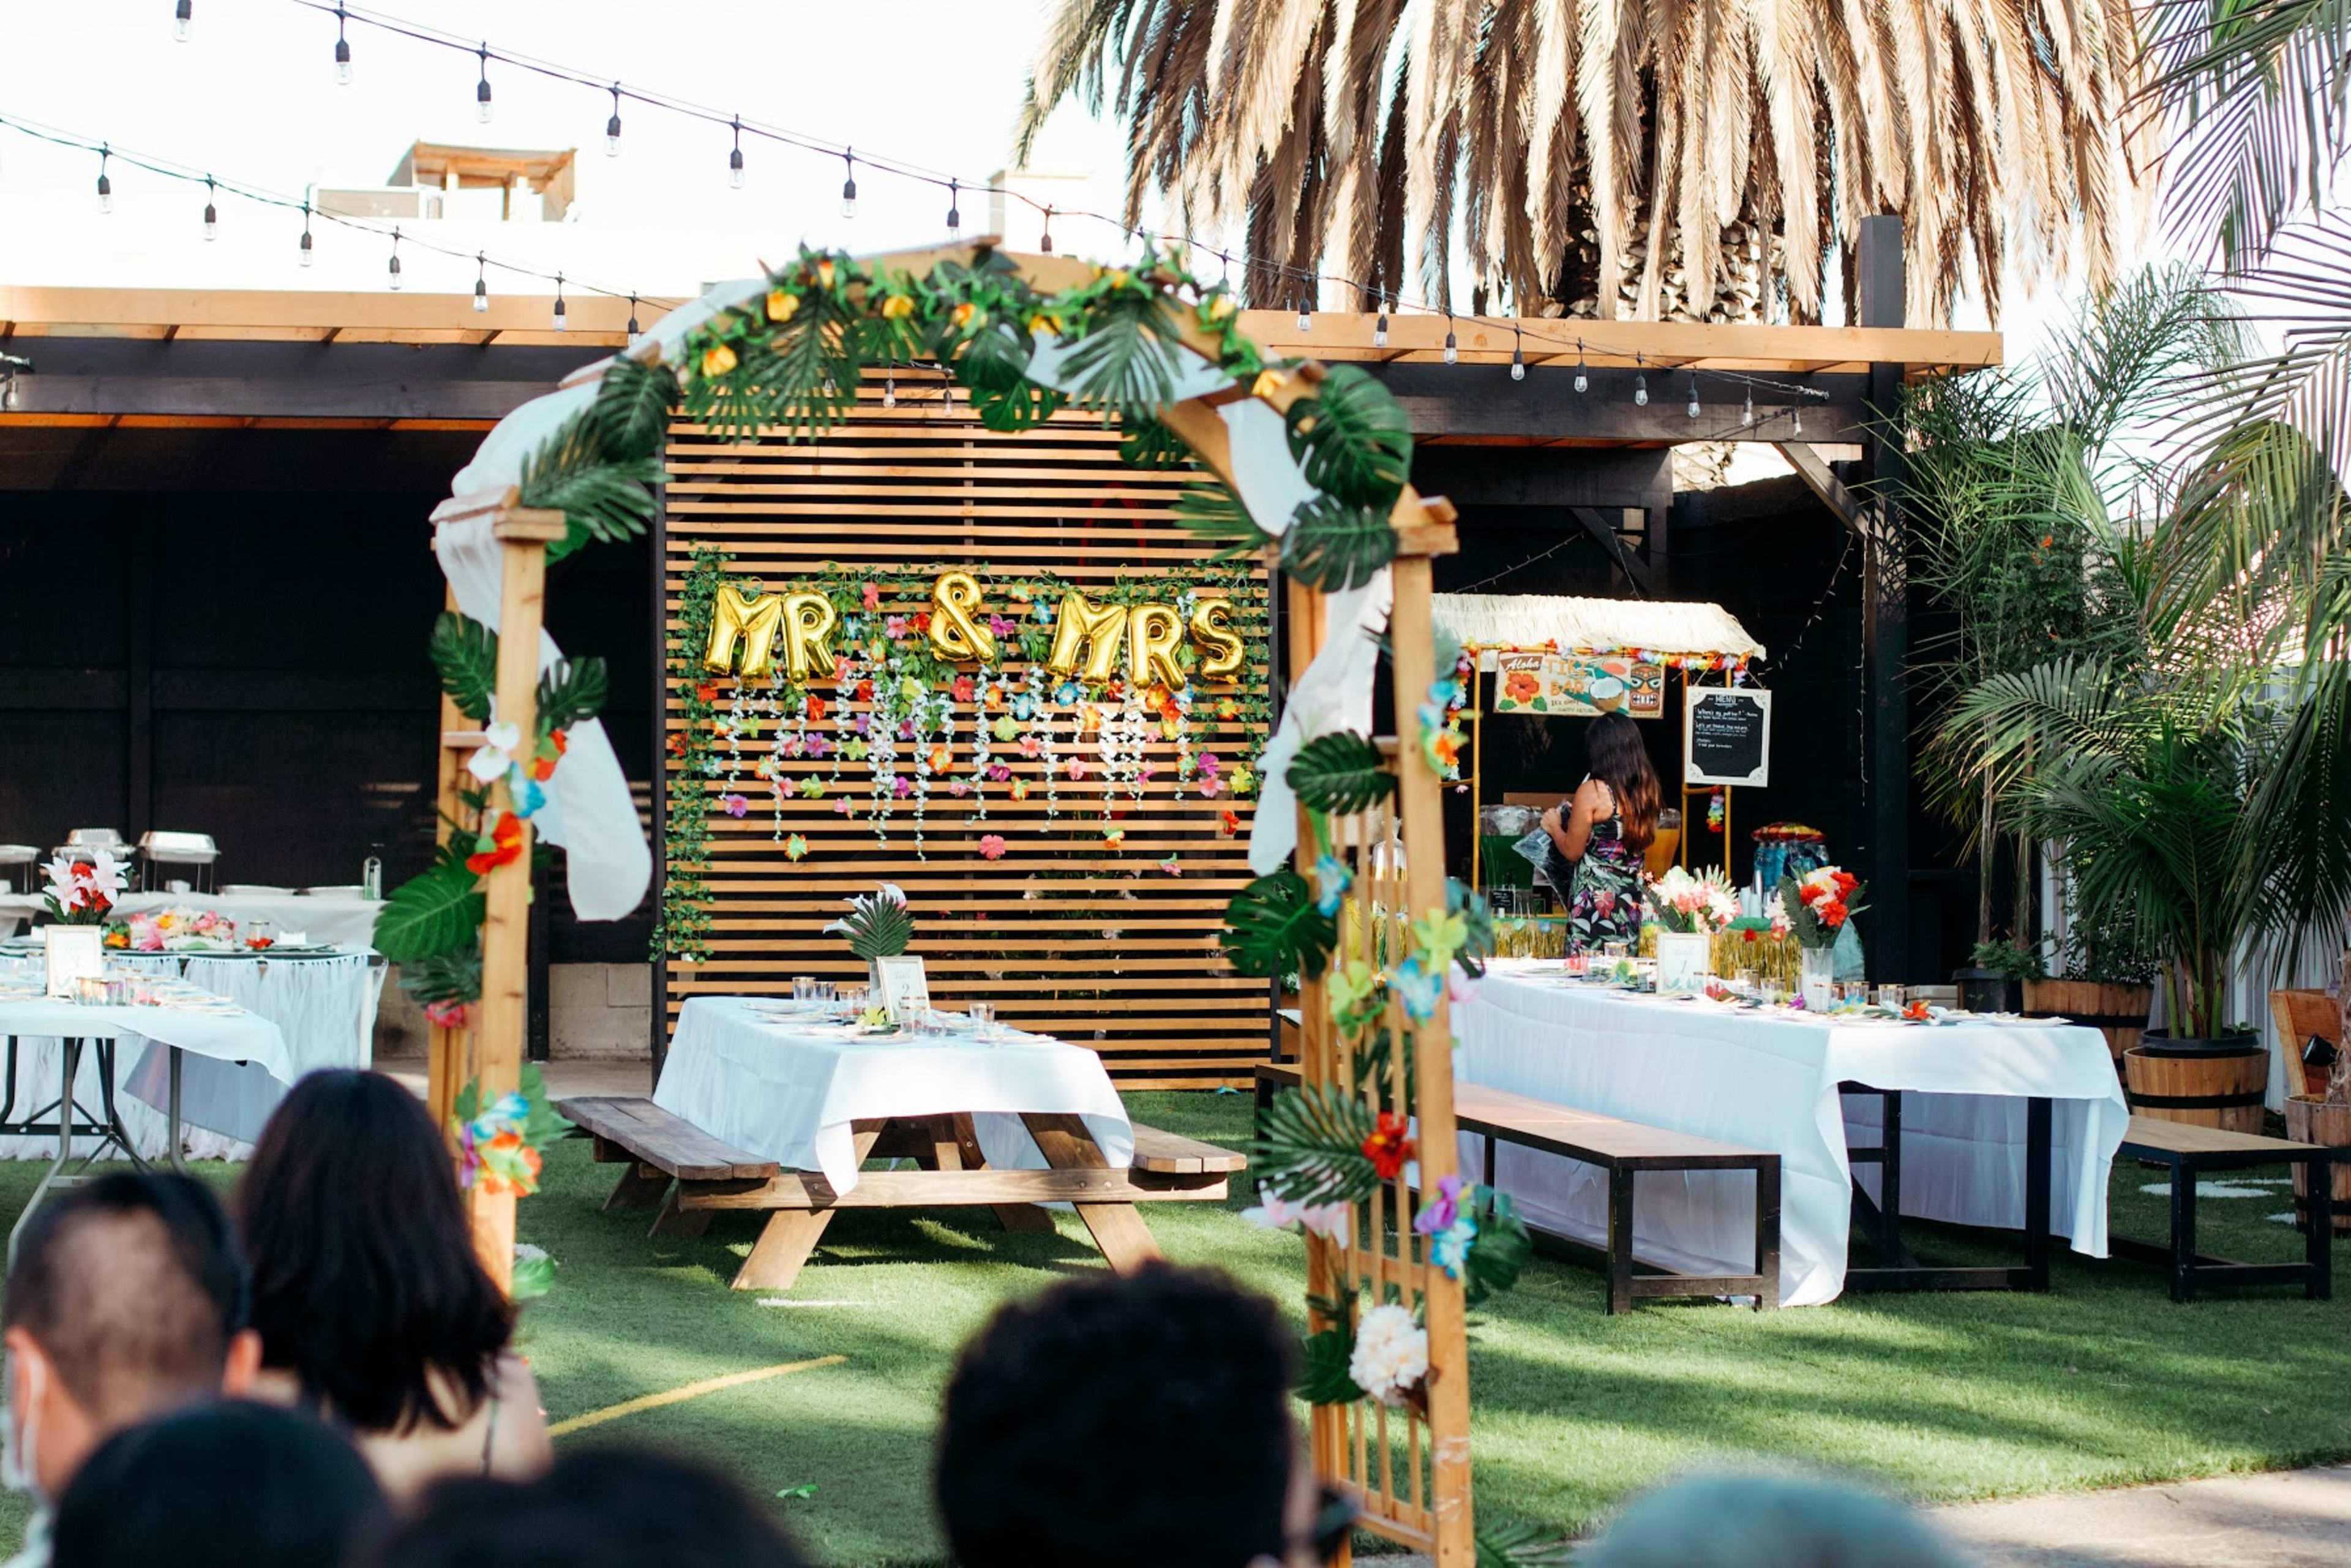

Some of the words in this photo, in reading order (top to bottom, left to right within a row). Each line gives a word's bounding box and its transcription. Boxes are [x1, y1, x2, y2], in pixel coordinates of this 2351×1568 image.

[703, 582, 838, 685] MR
[929, 569, 995, 665] &
[1046, 589, 1246, 692] MRS
[1506, 657, 1540, 672] Aloha
[1546, 659, 1587, 676] TIKI
[1551, 680, 1584, 696] BAR
